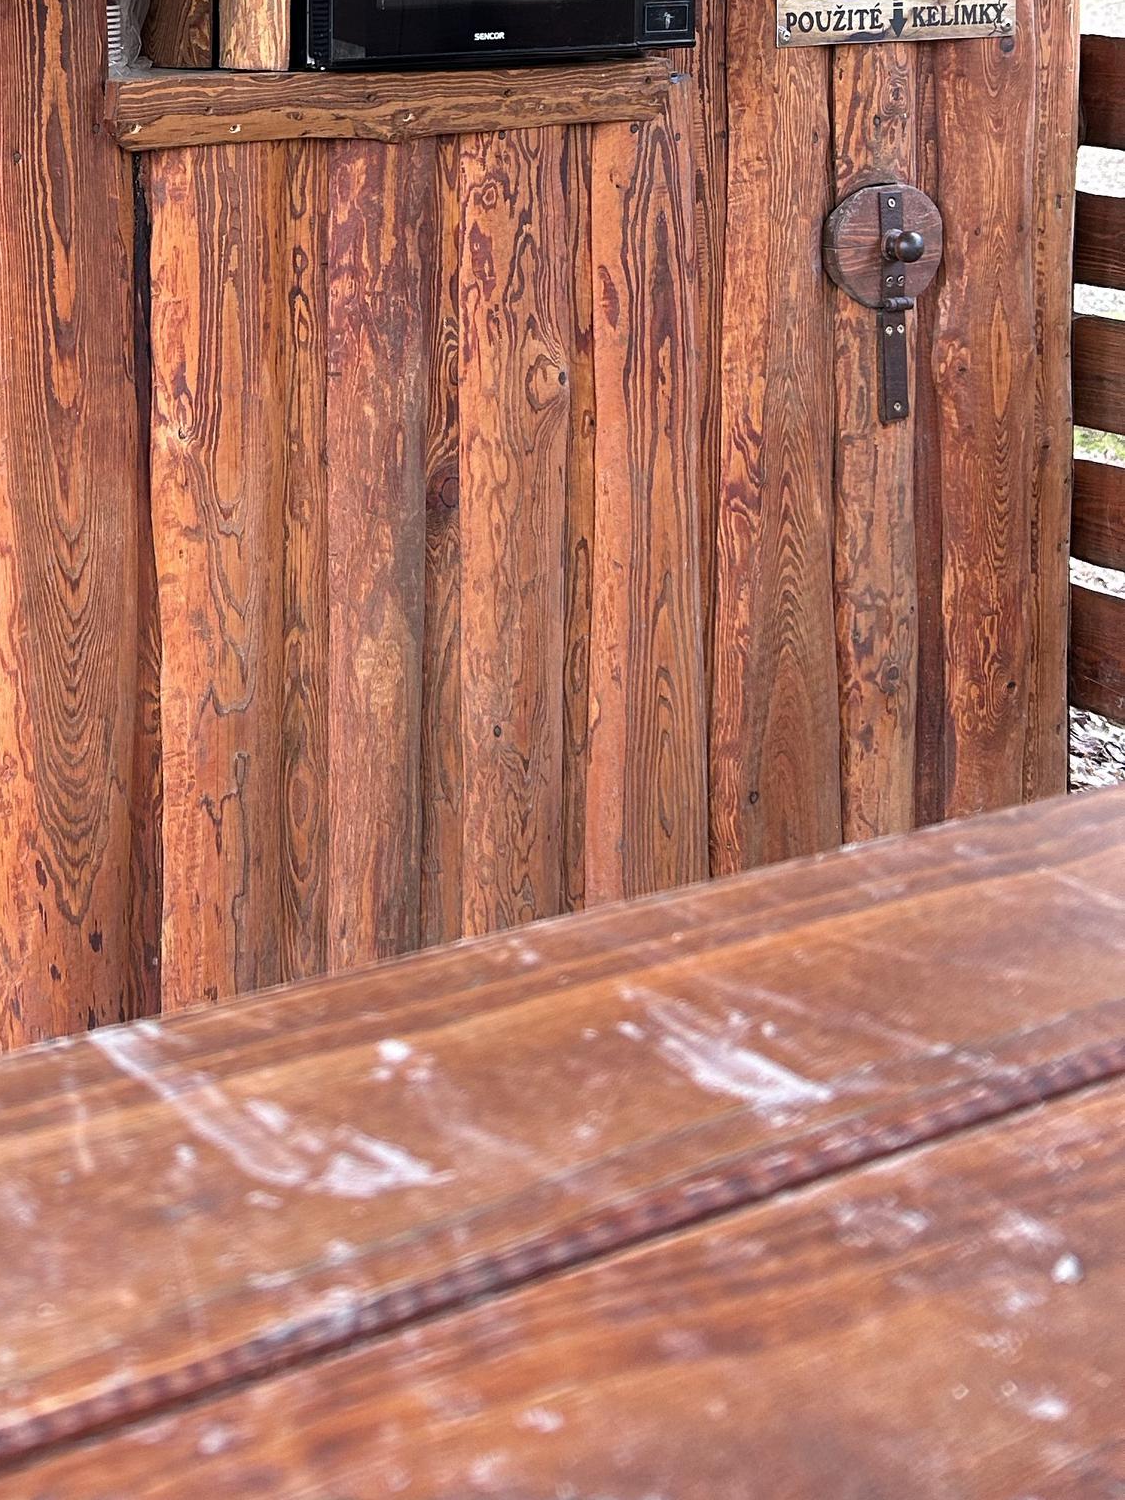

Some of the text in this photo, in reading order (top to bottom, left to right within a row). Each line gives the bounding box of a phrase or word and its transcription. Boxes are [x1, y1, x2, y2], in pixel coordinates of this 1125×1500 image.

[786, 0, 1007, 33] POUŽITÉ KELÍMKY
[474, 32, 505, 41] SENCOR
